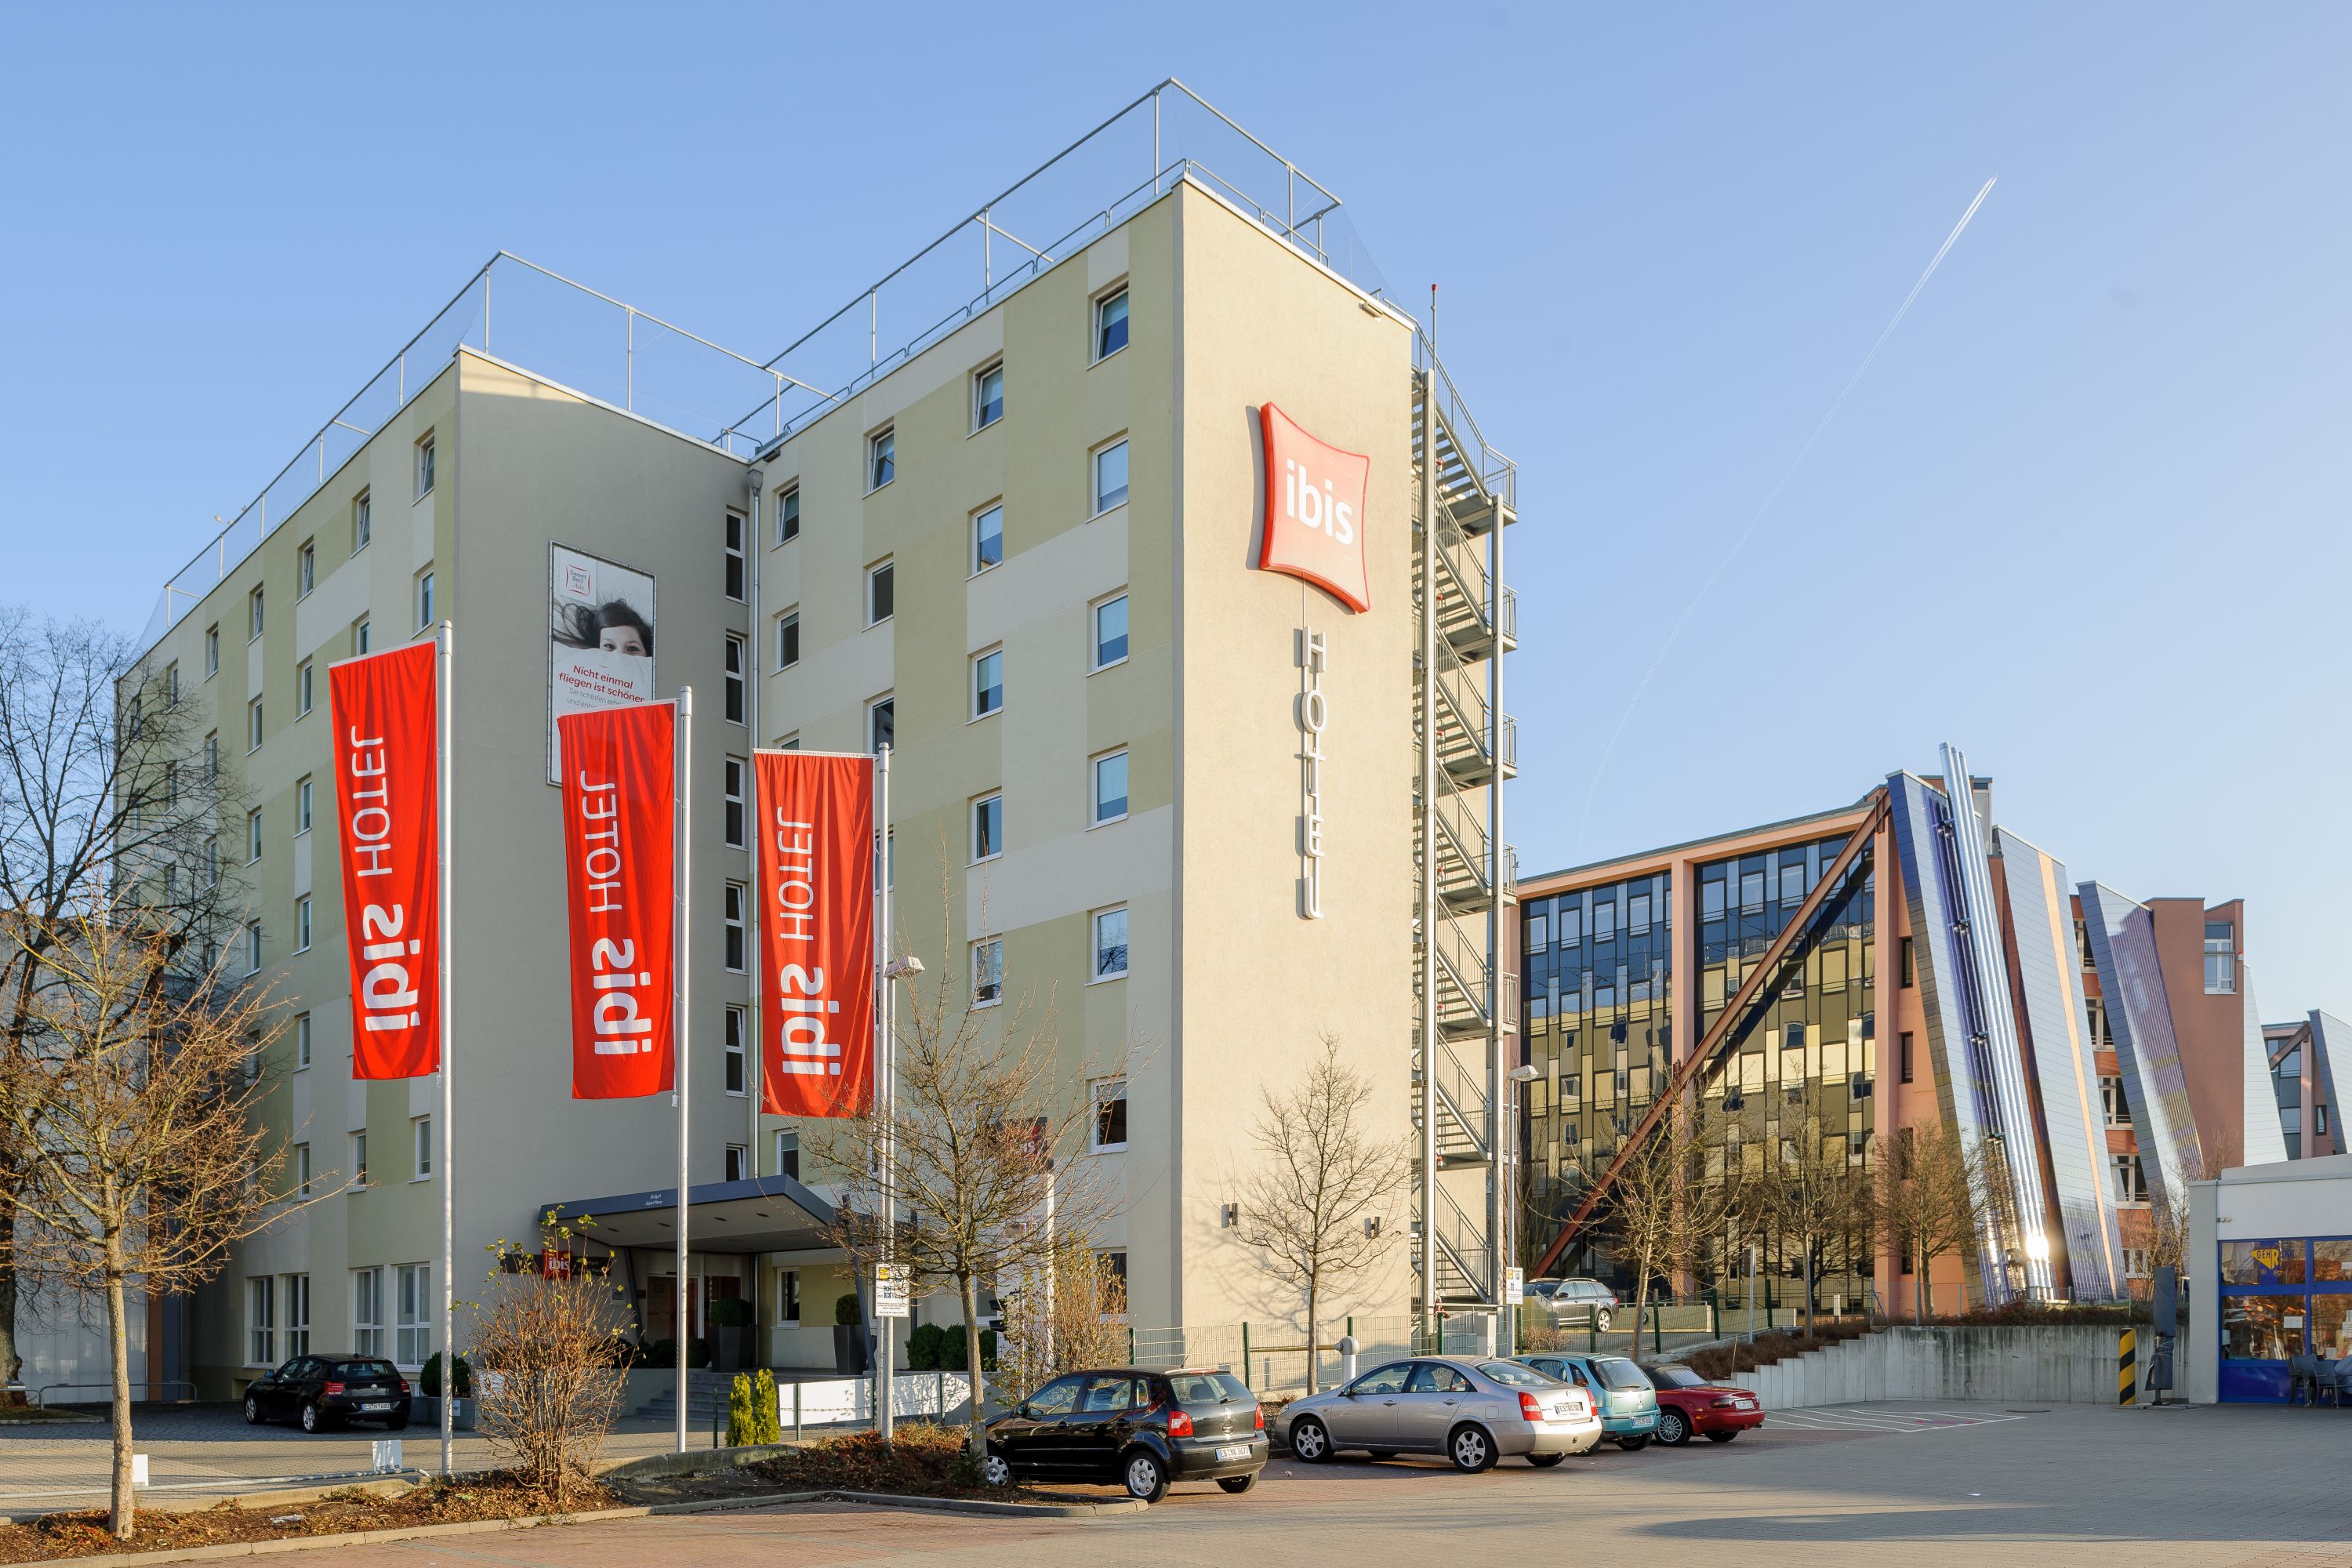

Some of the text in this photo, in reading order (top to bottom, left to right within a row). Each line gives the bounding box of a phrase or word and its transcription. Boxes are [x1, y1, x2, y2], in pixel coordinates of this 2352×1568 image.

[1287, 459, 1355, 545] ibis
[558, 672, 645, 702] fliegen ist schöner
[573, 665, 633, 690] Nicht einmal
[567, 698, 579, 706] und
[579, 691, 607, 703] schlafen
[1302, 626, 1329, 920] HOTEL
[549, 1257, 570, 1270] ibis
